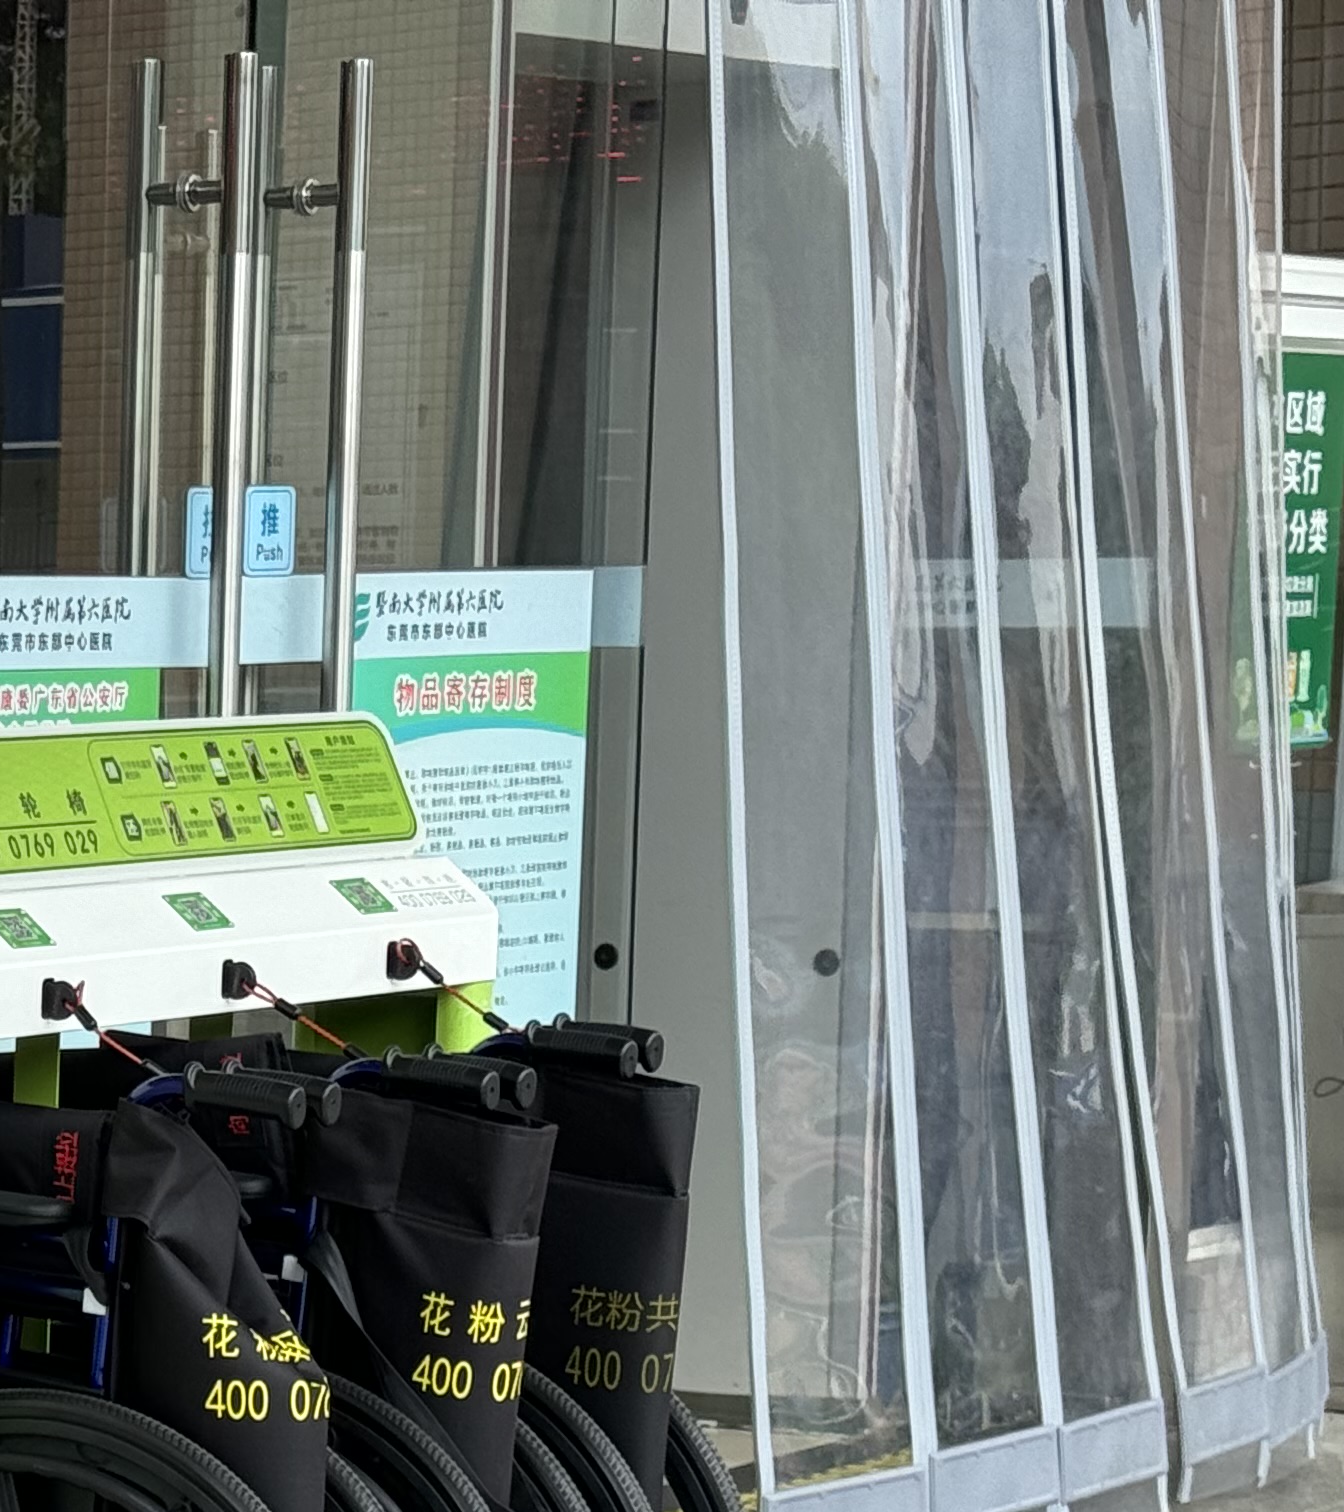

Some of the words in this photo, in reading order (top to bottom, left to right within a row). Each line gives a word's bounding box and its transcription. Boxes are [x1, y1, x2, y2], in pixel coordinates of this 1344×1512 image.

[261, 501, 280, 537] 推
[255, 543, 283, 561] Push
[375, 588, 505, 618] 暨南大学附属第六医院
[386, 621, 488, 642] 东莞市东部中心医院
[395, 671, 536, 715] 物品寄存制度
[7, 832, 55, 860] 0769
[64, 829, 99, 855] 029
[412, 1354, 473, 1400] 400
[492, 1361, 524, 1403] 07
[564, 1345, 622, 1391] 400
[204, 1378, 270, 1422] 400
